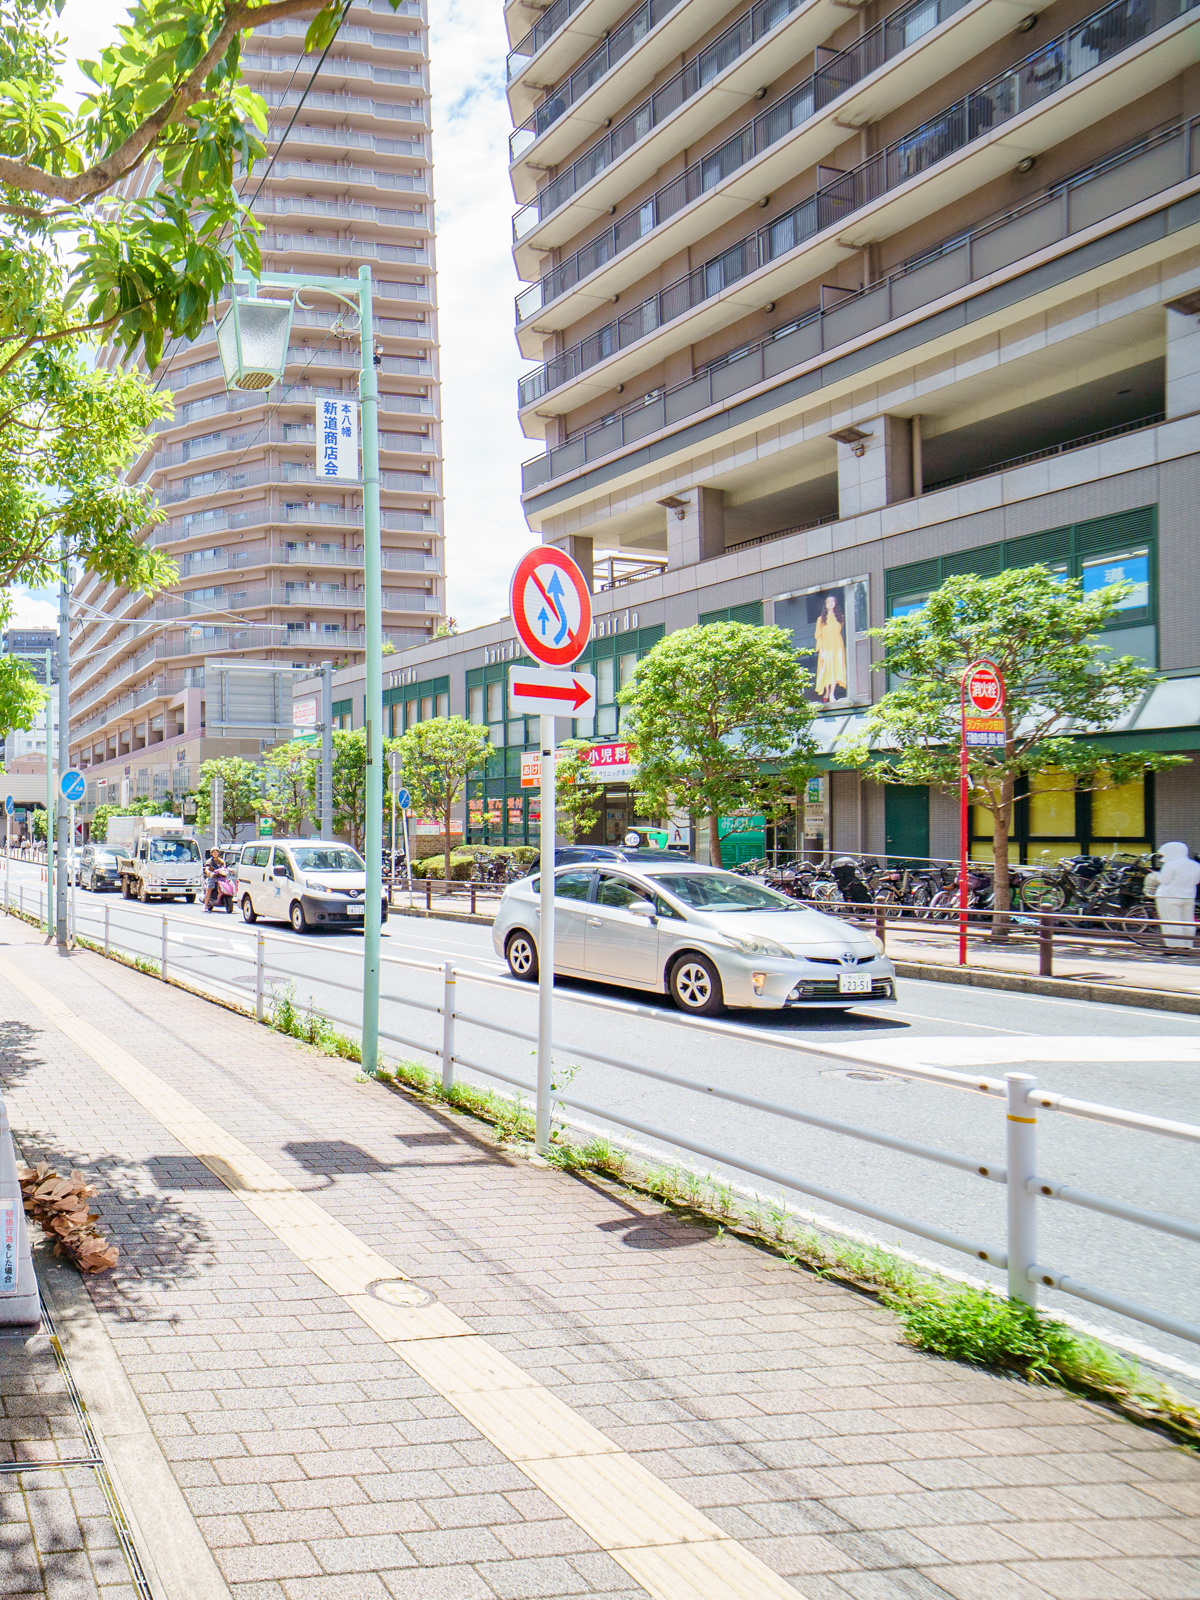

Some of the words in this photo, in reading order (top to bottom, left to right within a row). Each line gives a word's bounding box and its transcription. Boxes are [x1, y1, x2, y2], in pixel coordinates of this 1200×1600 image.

[341, 404, 352, 438] 本八幡
[323, 401, 338, 476] 新道商店会
[591, 614, 618, 639] hair
[623, 609, 639, 631] do
[485, 643, 505, 664] hair
[509, 639, 520, 659] do
[389, 670, 405, 688] hair
[408, 666, 417, 683] do
[972, 682, 997, 698] 消火栓
[966, 719, 1004, 731] ランディック市川
[523, 764, 541, 776] あけ
[847, 980, 869, 991] 23-51
[4, 1210, 14, 1284] 破損行為をした場合
